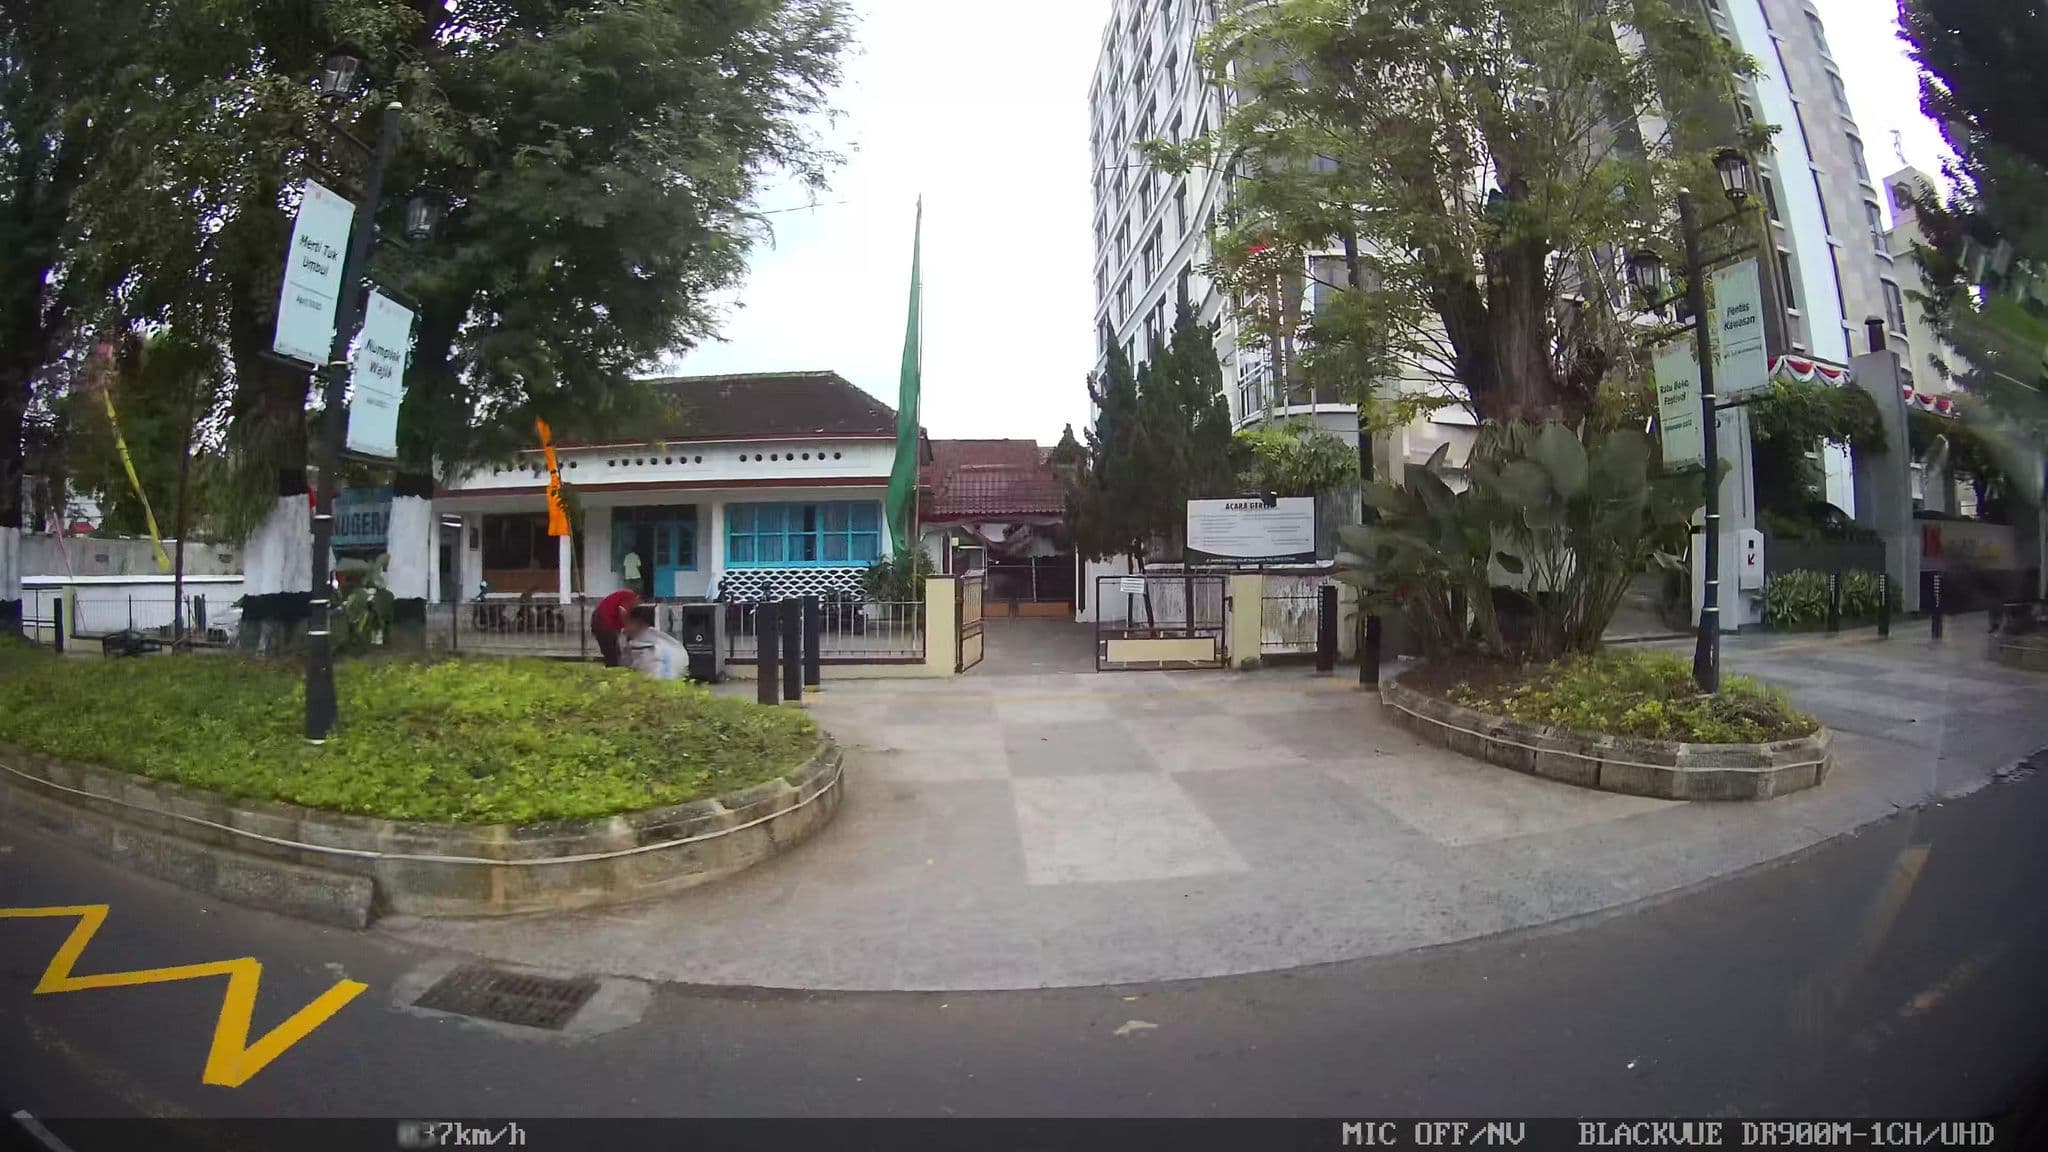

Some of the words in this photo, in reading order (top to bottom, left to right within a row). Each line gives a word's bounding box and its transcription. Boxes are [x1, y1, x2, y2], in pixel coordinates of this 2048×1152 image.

[323, 244, 339, 261] Tuk
[303, 256, 329, 277] Umbul
[1726, 302, 1751, 317] Pentas
[1723, 315, 1756, 331] Kawasan
[1664, 391, 1687, 406] Festival
[1225, 502, 1248, 511] ACARA
